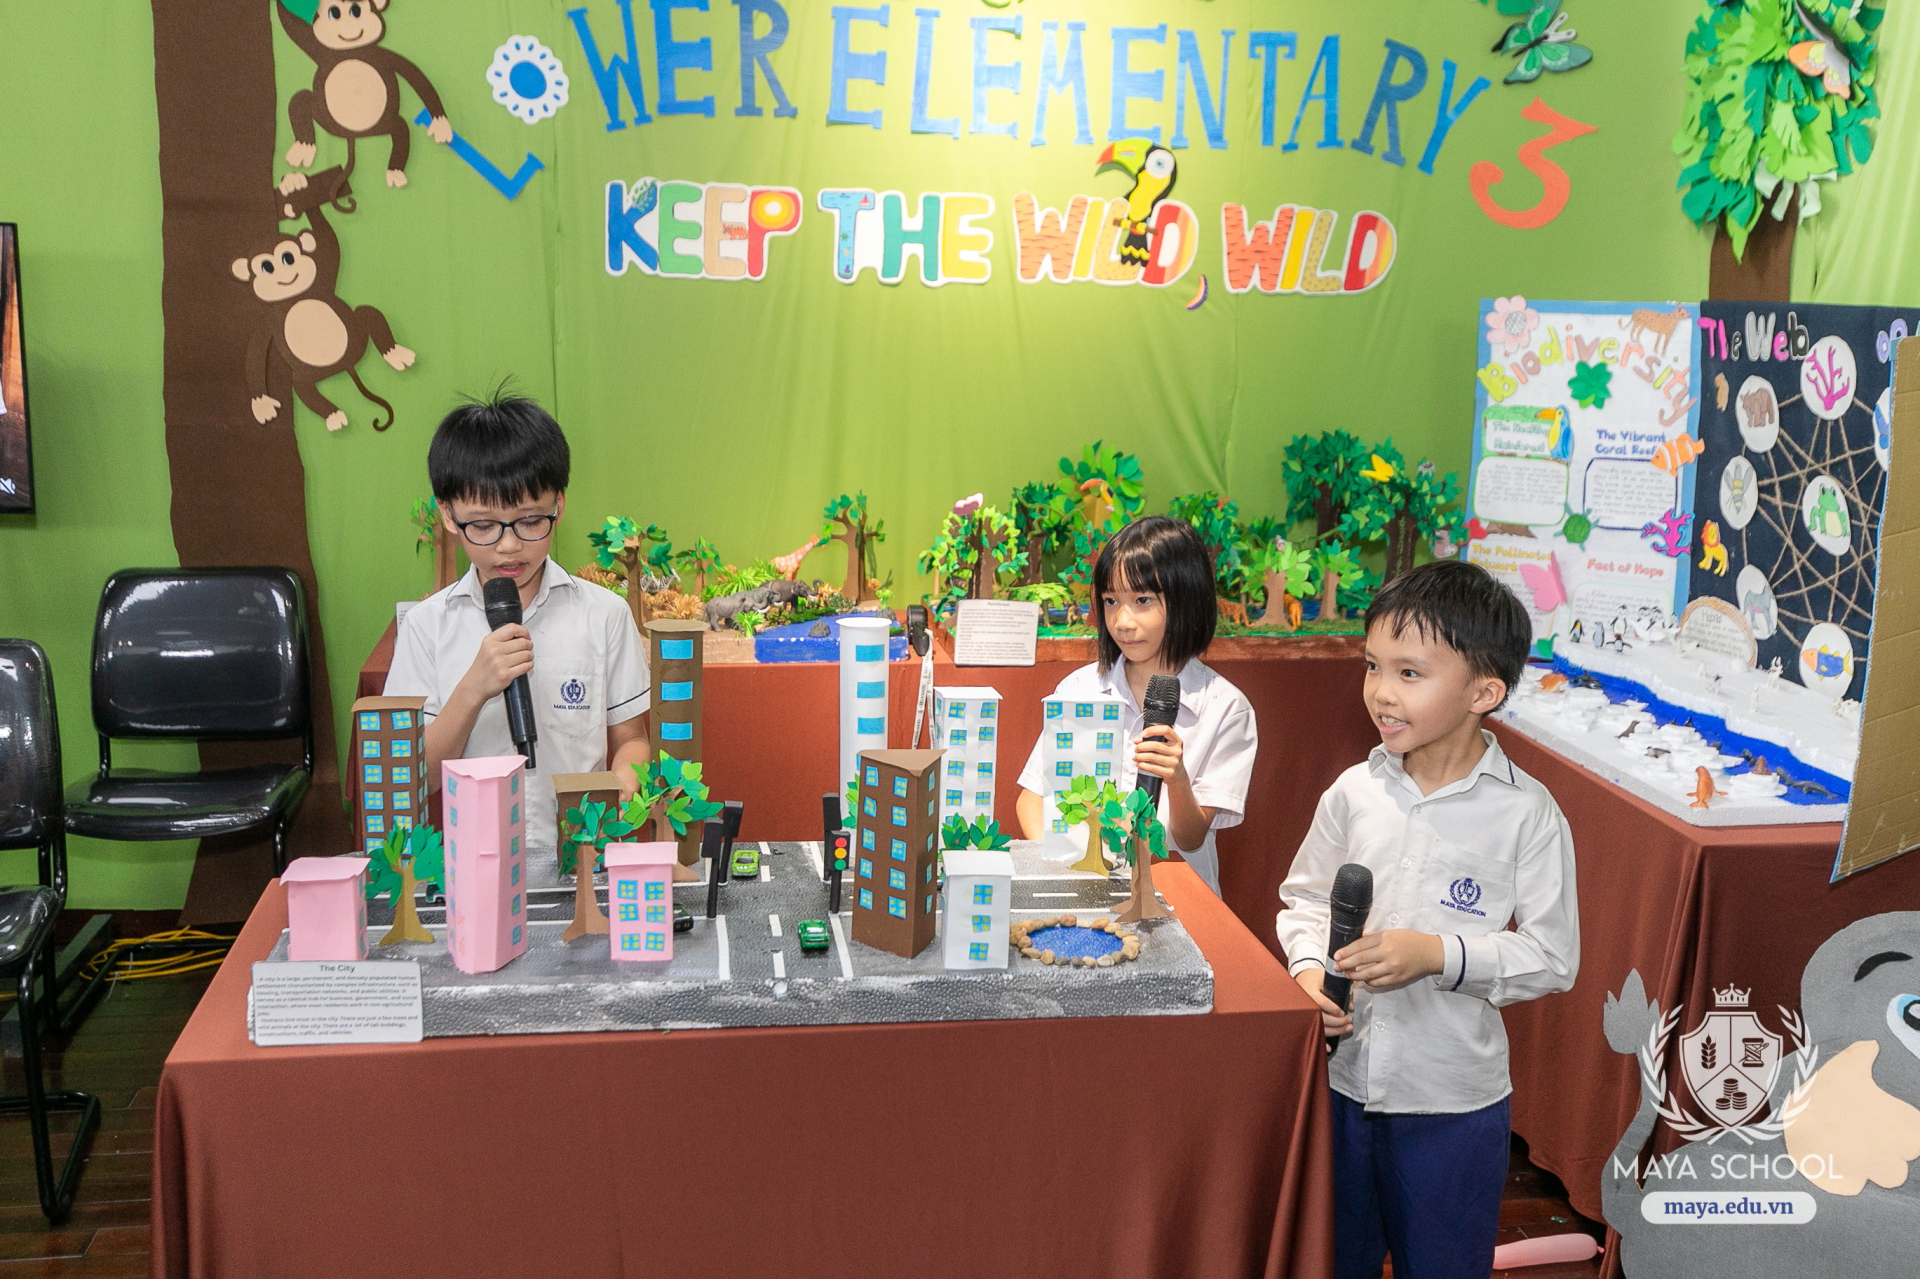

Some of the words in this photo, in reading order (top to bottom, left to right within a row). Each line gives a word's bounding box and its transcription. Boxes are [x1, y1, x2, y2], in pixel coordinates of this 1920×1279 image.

[826, 3, 1491, 175] ELEMENTARY
[1469, 95, 1599, 230] 3
[605, 177, 803, 281] KEEP
[817, 188, 996, 287] THE
[1221, 203, 1397, 293] WILD
[1744, 311, 1809, 362] Web
[1477, 323, 1697, 426] Biodiversity
[1596, 429, 1616, 440] The
[1620, 430, 1666, 443] Vibrant
[1595, 443, 1627, 454] Coral
[1632, 444, 1658, 455] Reef
[1472, 544, 1491, 555] The
[1587, 558, 1614, 572] Fact
[1618, 562, 1632, 573] of
[1634, 563, 1664, 578] Hope
[1440, 899, 1456, 909] MAYA
